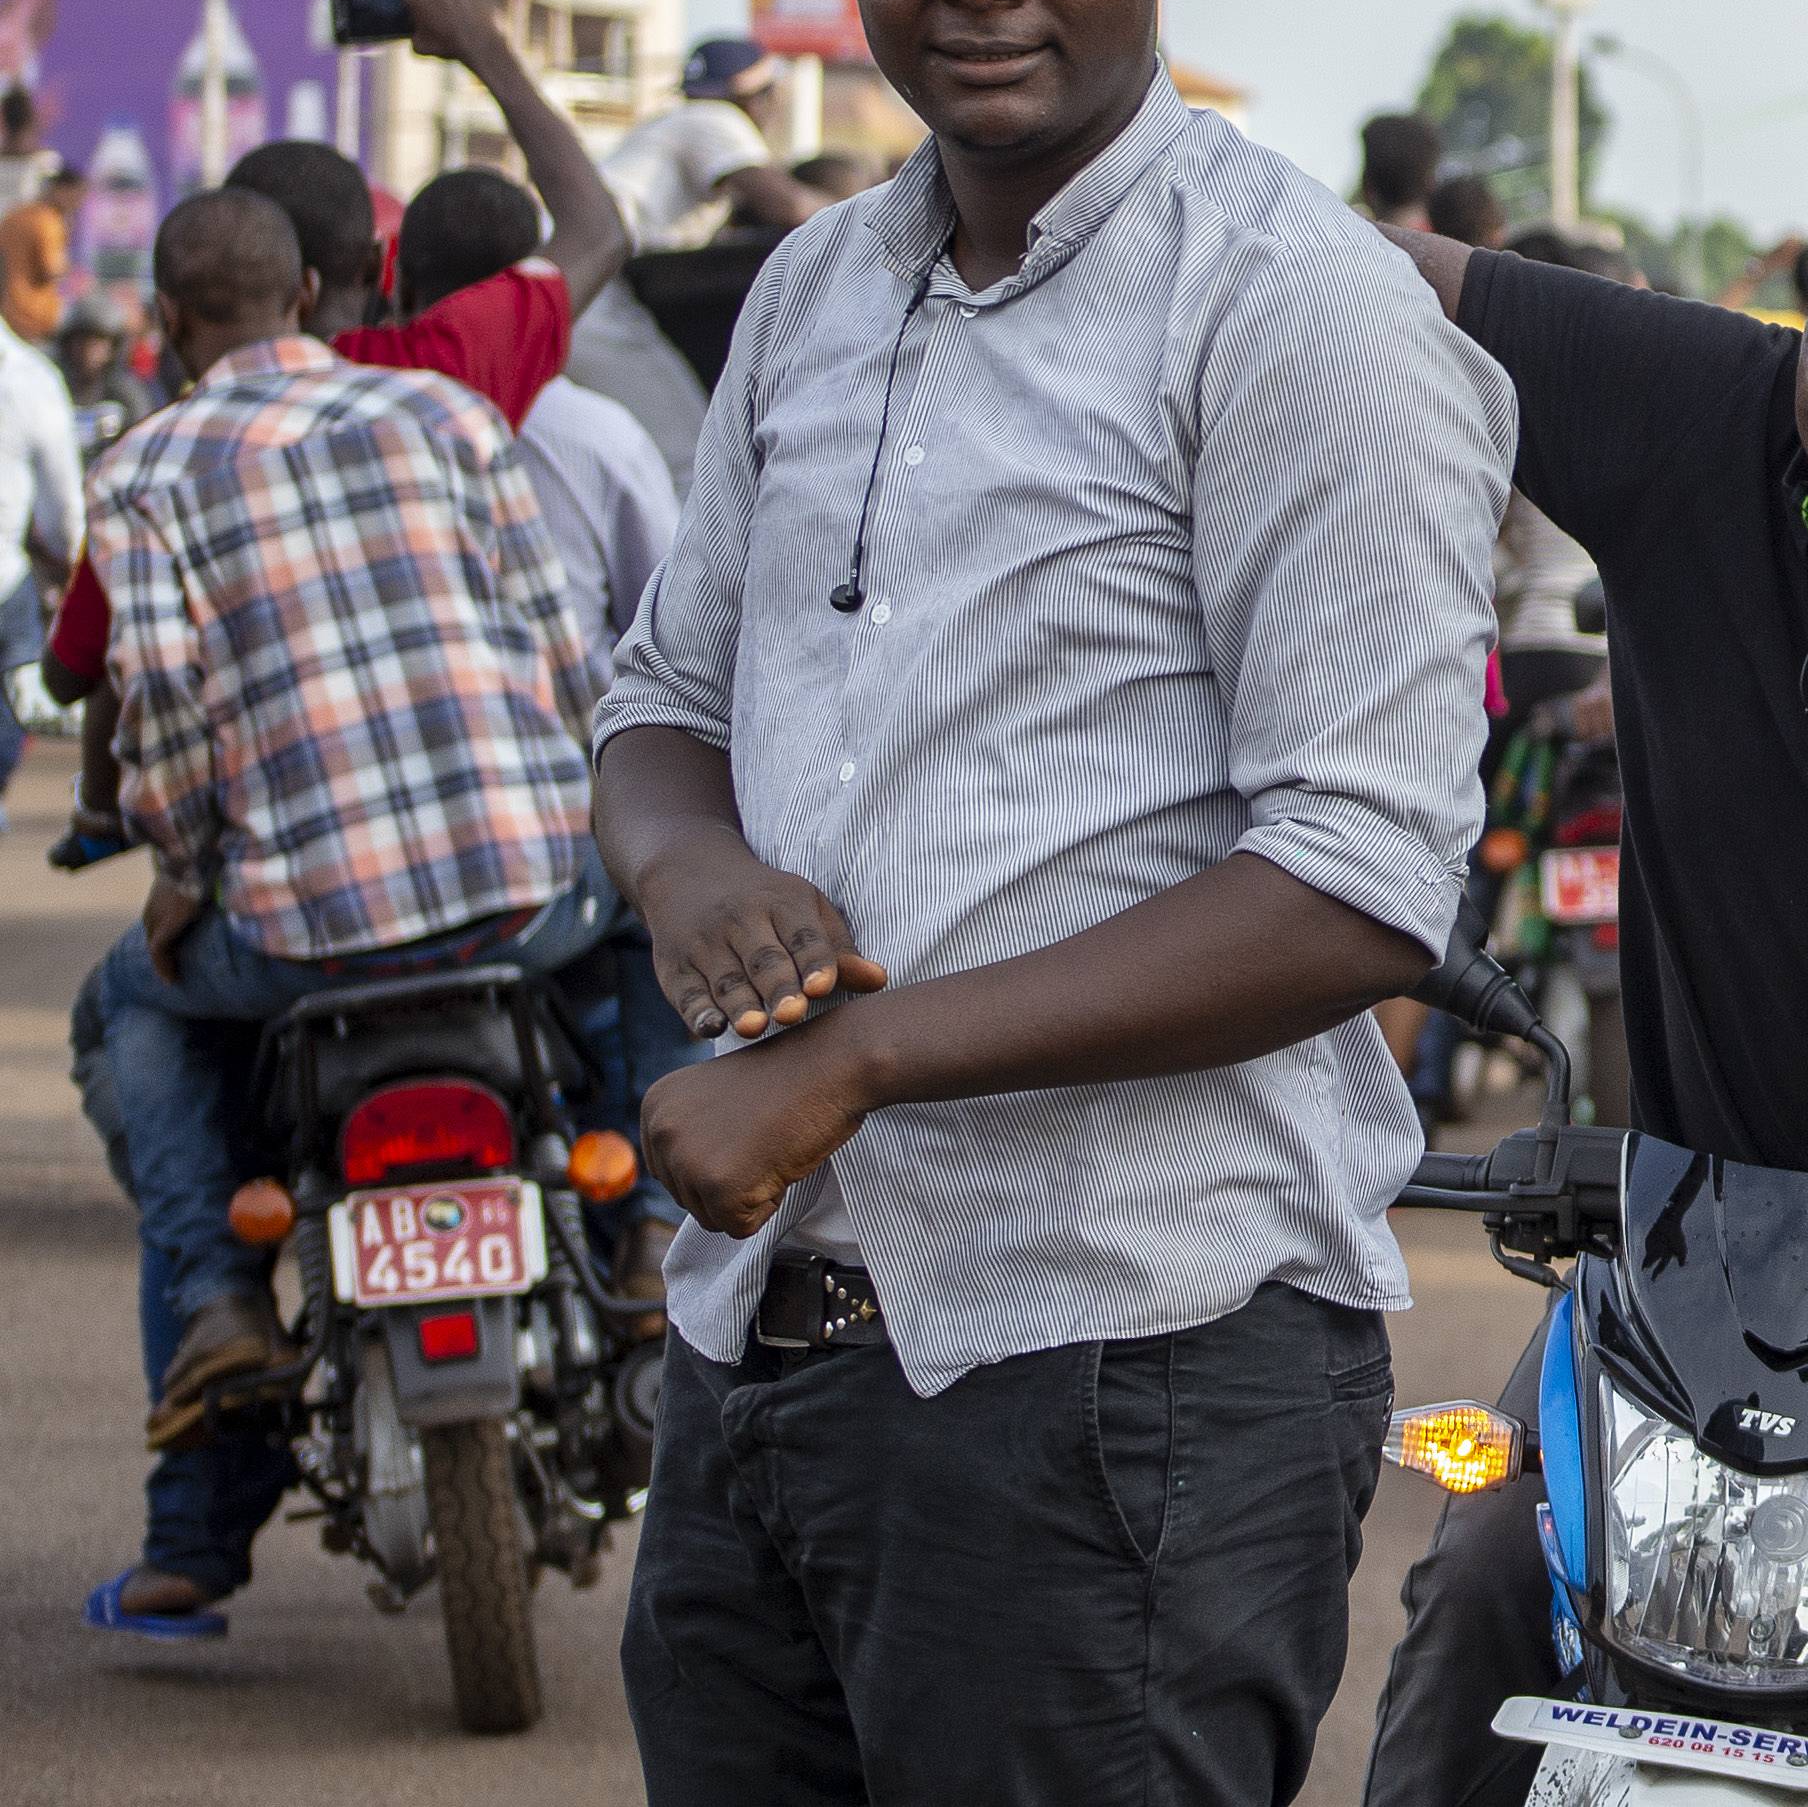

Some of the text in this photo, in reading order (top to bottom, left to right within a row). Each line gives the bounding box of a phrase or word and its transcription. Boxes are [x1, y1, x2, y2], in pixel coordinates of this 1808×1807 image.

[362, 1195, 417, 1249] AB
[367, 1234, 514, 1292] 4540
[1738, 1407, 1797, 1437] TVS
[1647, 1735, 1776, 1764] 620 08 15 15
